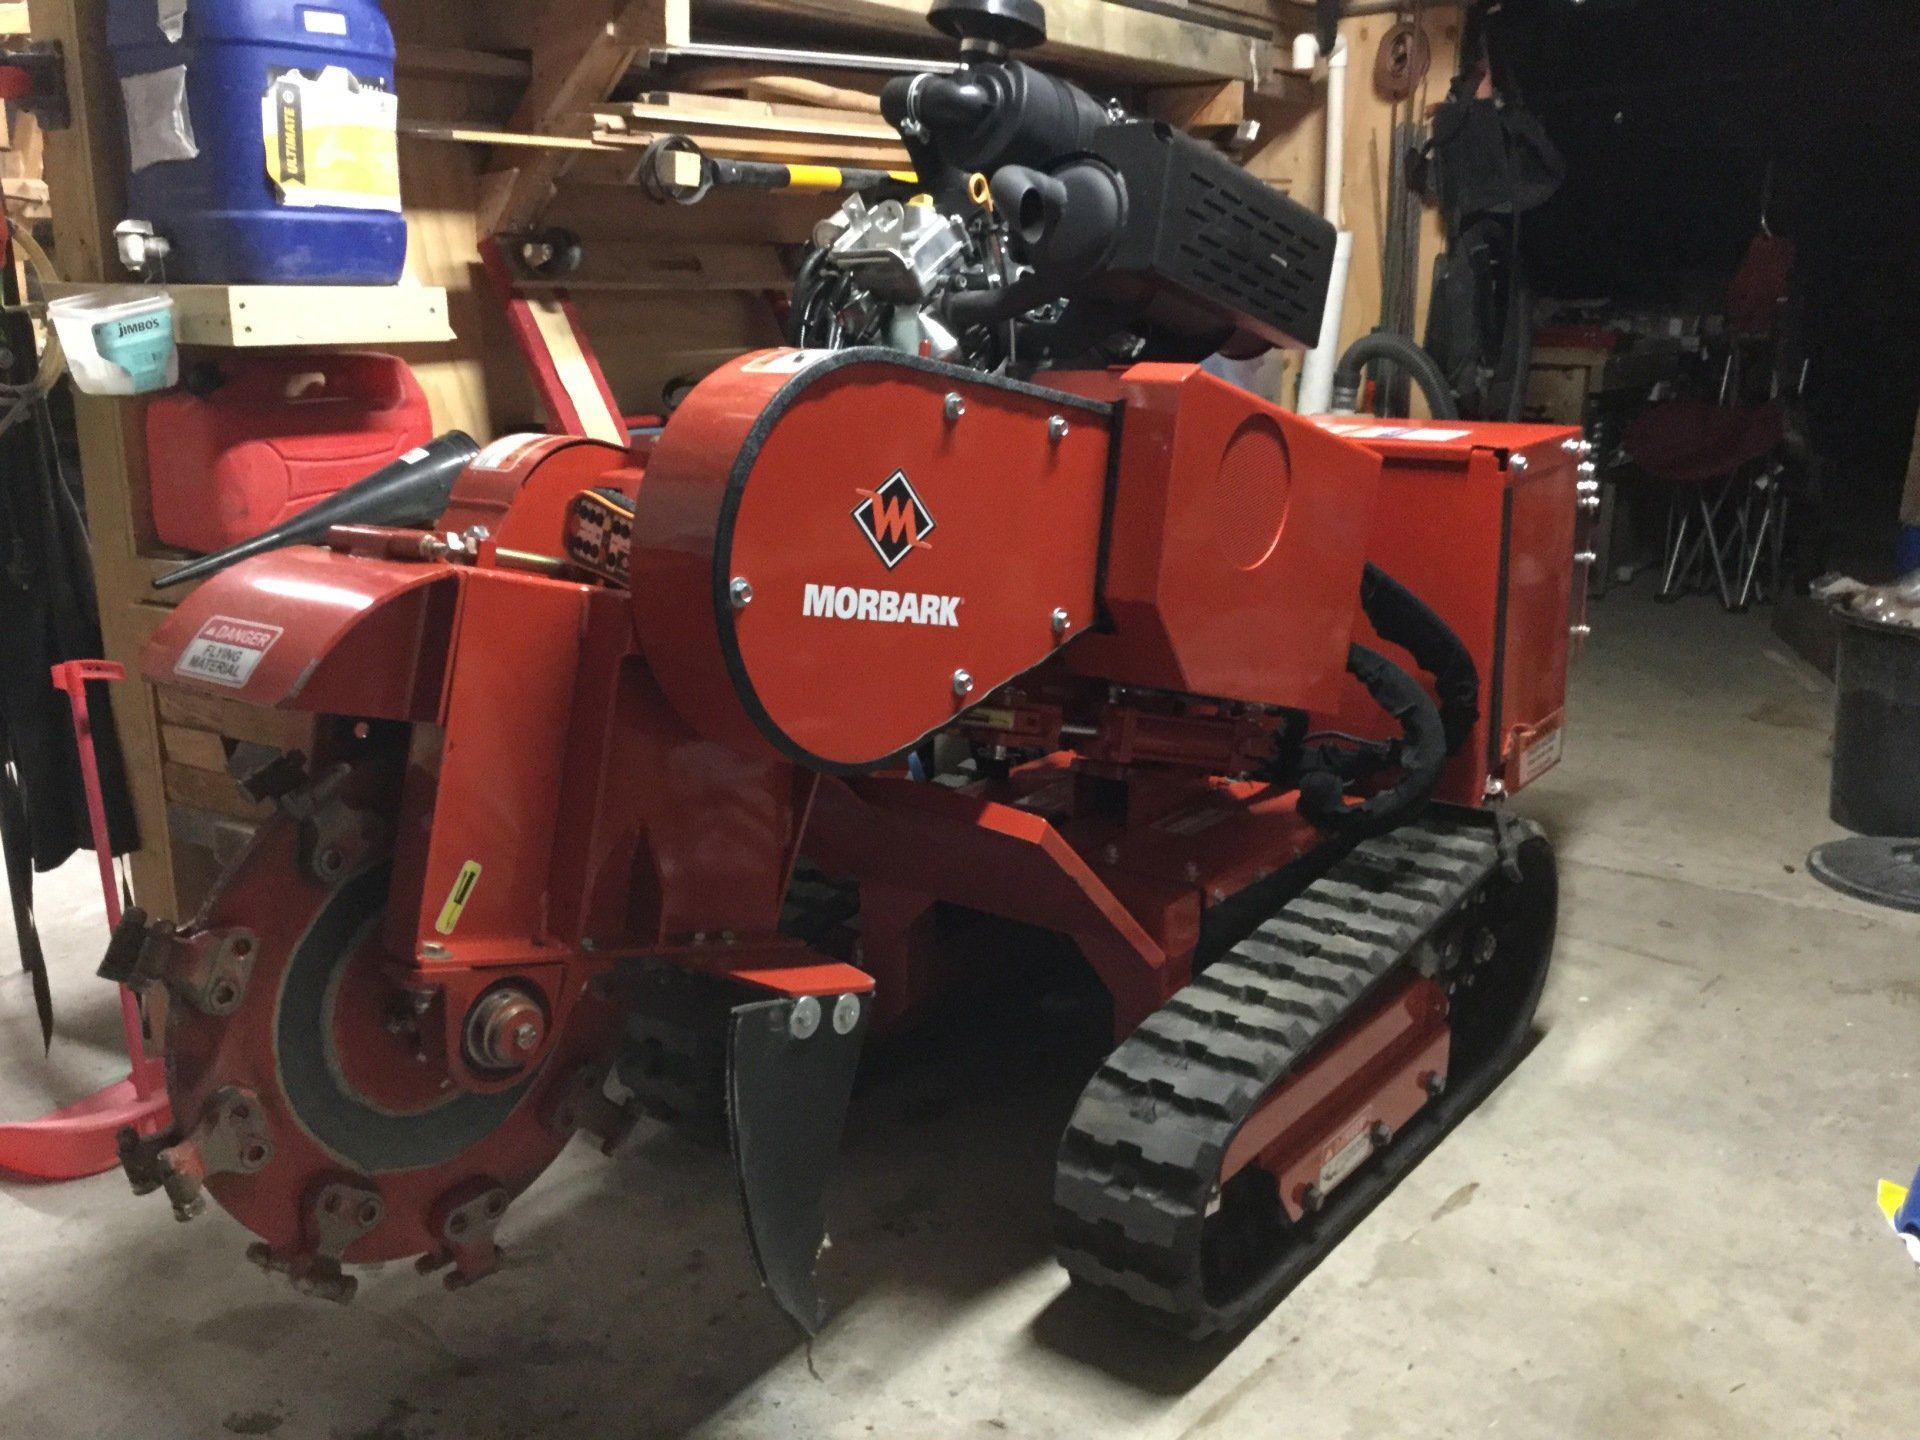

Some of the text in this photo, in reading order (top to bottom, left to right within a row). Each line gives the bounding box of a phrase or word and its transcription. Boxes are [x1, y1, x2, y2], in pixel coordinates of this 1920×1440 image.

[283, 106, 298, 174] ULTIMATE
[803, 583, 961, 627] MORBARK
[214, 625, 271, 648] DANGER
[203, 645, 243, 662] FLYING
[188, 656, 240, 677] MATERIAL
